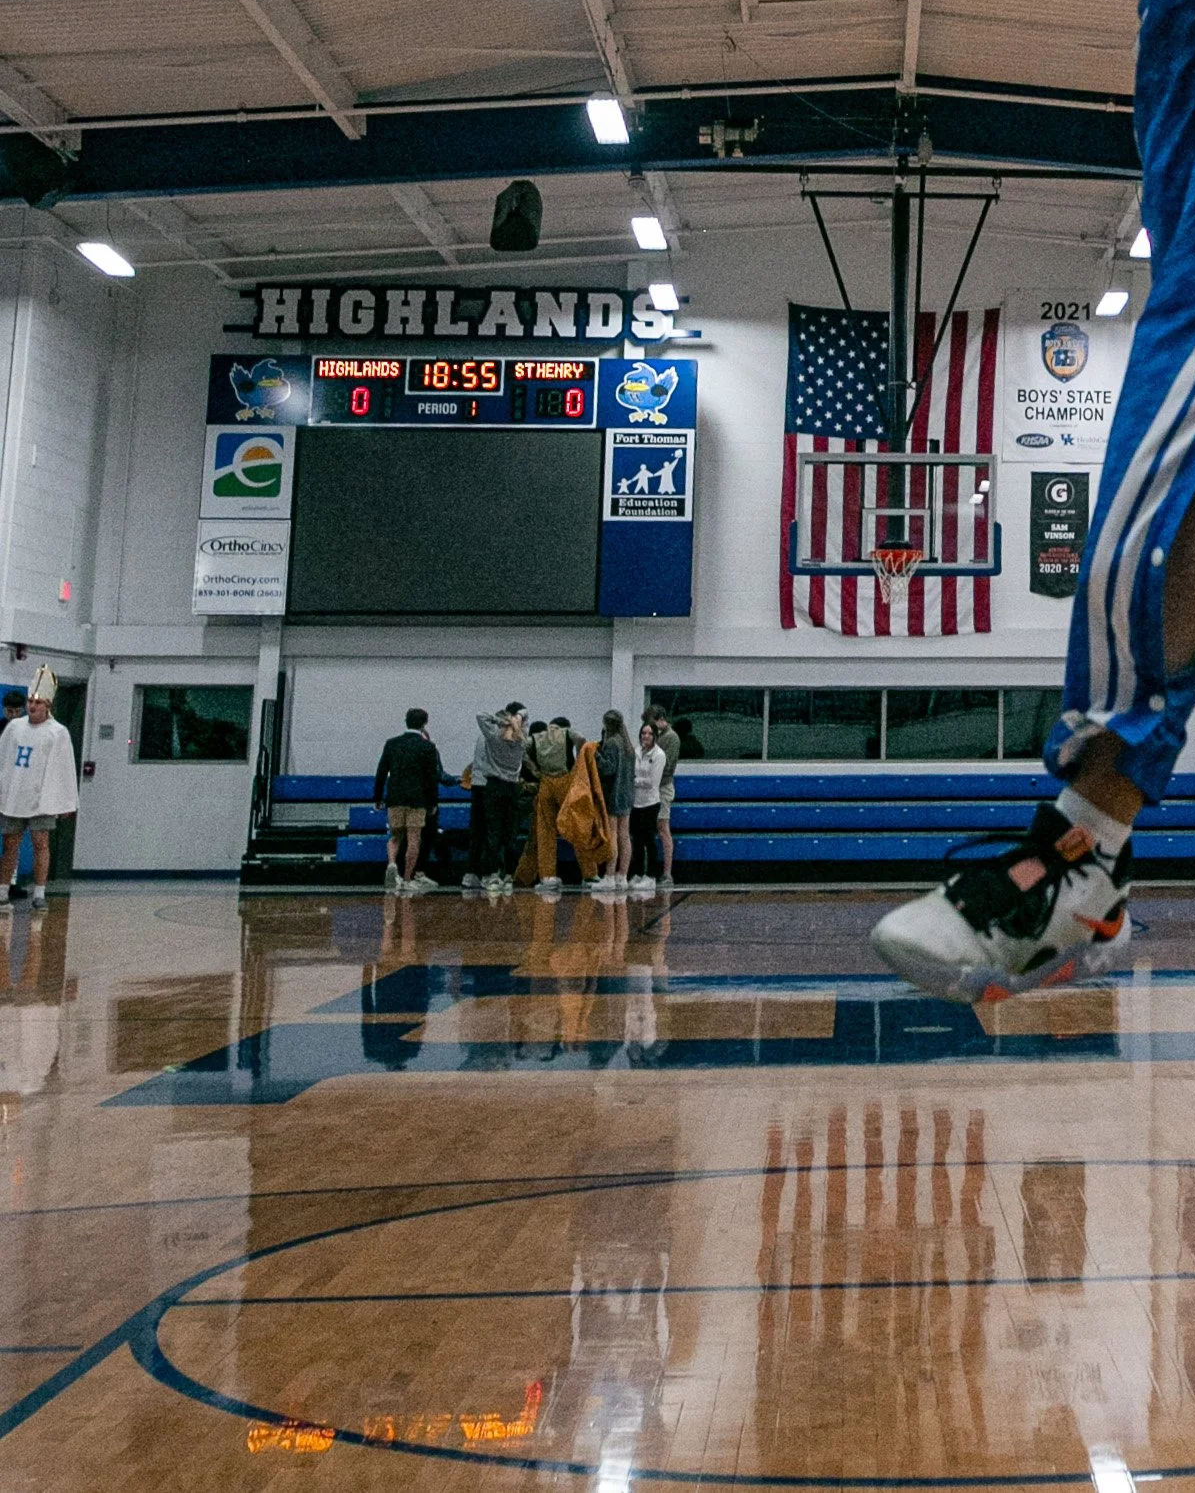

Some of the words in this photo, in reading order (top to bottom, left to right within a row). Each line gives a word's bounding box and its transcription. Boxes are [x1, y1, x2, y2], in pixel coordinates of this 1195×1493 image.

[259, 288, 672, 339] HIGHLANDS
[1040, 302, 1091, 321] 2021
[319, 361, 400, 377] HIGHLANDS
[423, 361, 497, 389] 18:55
[352, 387, 370, 415] 0
[565, 388, 584, 418] 0
[1017, 389, 1062, 404] BOYS'
[1066, 390, 1113, 405] STATE
[418, 403, 458, 415] PERIOD
[470, 401, 477, 417] 1
[1024, 406, 1105, 421] CHAMPION
[615, 433, 640, 443] Fort
[642, 433, 686, 444] Thomas
[1051, 483, 1068, 503] G
[618, 498, 678, 507] Education
[618, 507, 678, 516] Foundation
[1050, 523, 1069, 532] SAM
[1044, 531, 1076, 540] VINSON
[210, 539, 285, 554] OrthoCincy
[1039, 563, 1062, 574] 2020
[202, 575, 280, 585] OrthoCincy.com
[15, 745, 33, 768] H
